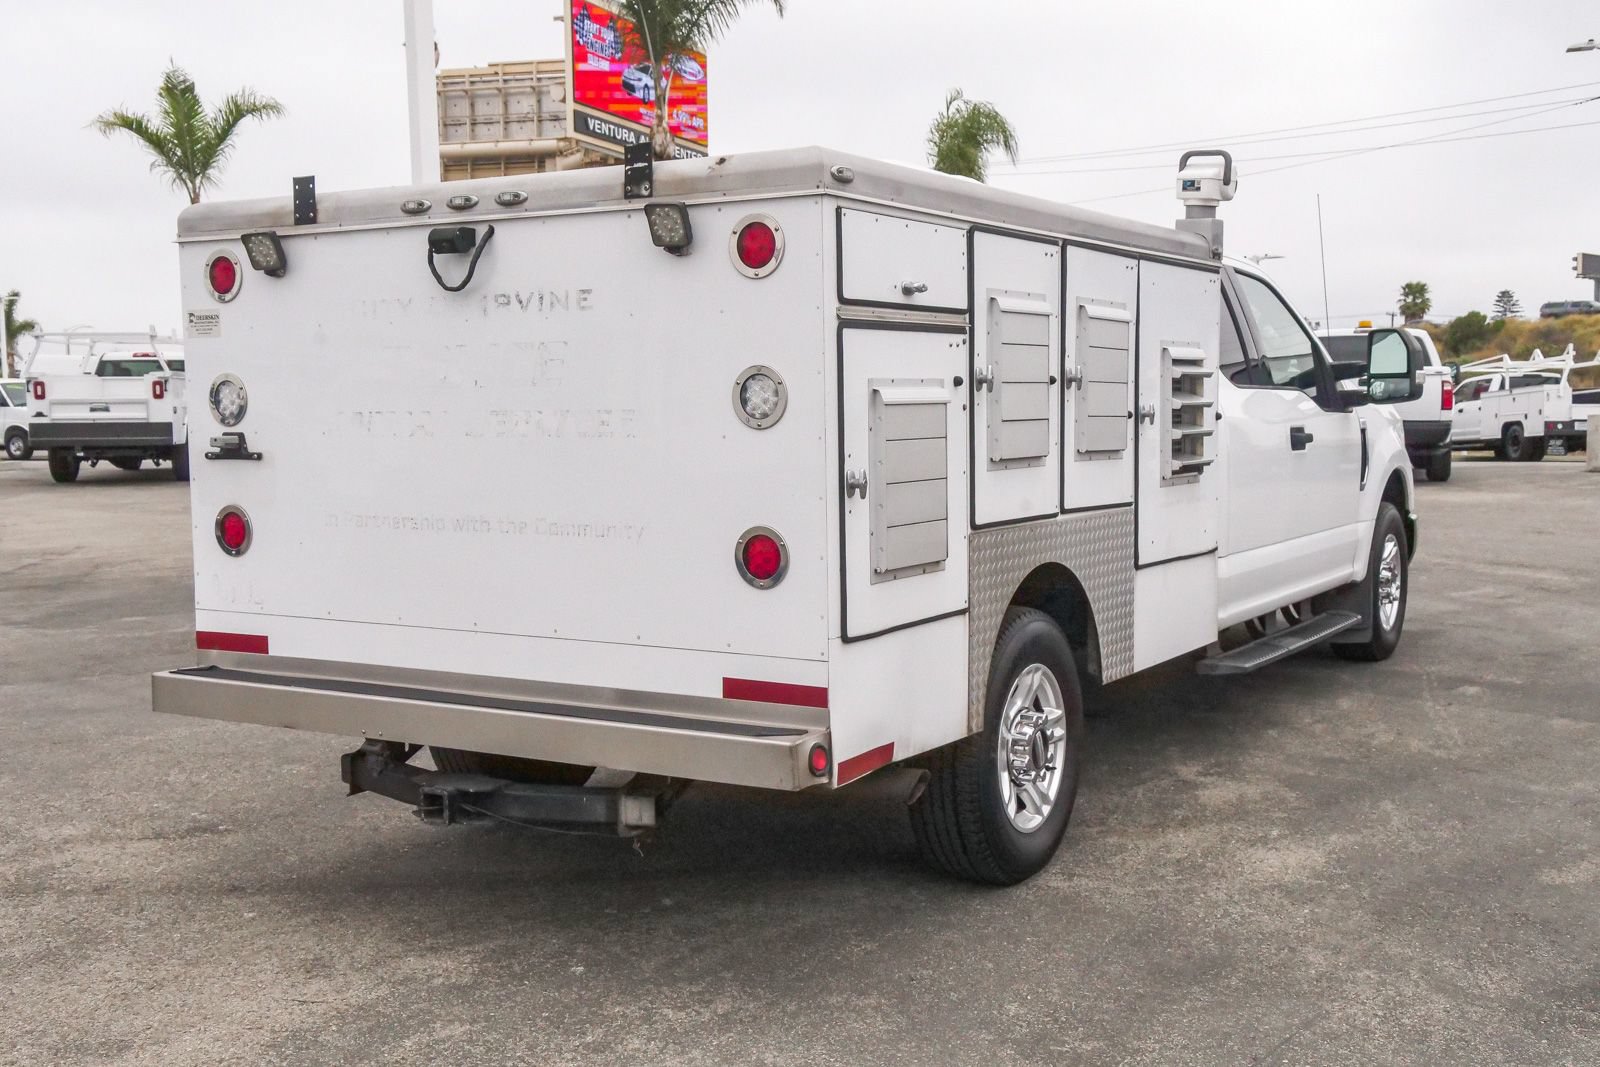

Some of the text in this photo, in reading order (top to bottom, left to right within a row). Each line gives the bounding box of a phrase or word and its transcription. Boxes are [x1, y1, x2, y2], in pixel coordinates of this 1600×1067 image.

[587, 117, 636, 144] VENTURA
[691, 116, 704, 130] APR
[482, 288, 594, 316] IRVINE
[452, 513, 491, 534] with
[497, 516, 528, 536] the
